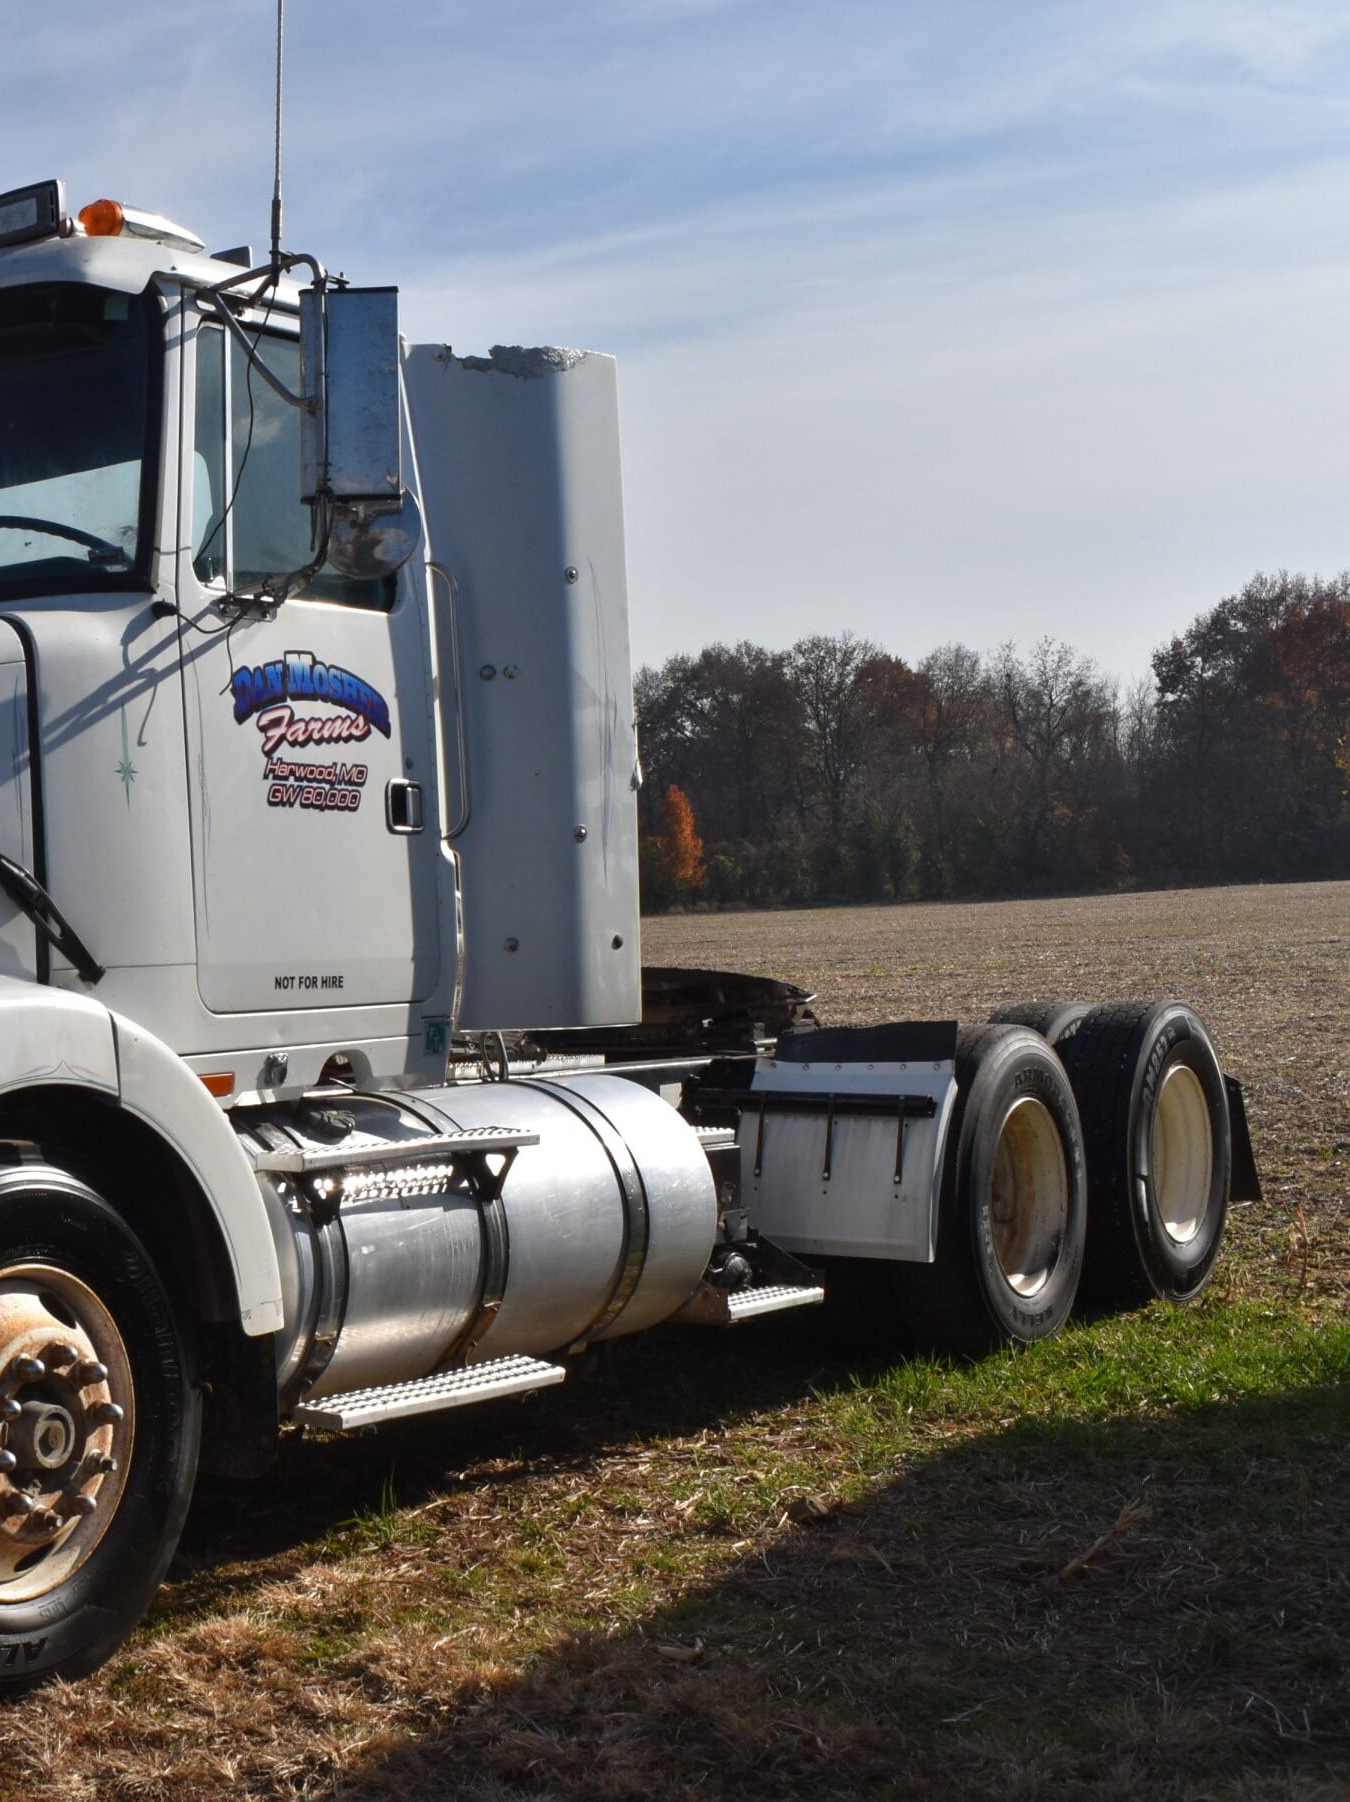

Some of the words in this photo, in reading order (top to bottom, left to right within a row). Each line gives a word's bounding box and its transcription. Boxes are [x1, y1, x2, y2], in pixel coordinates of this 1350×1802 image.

[231, 661, 287, 725] DAN
[256, 705, 372, 757] Farms
[263, 757, 338, 787] Harwood,
[337, 763, 368, 787] MO
[267, 783, 300, 807] GW
[300, 785, 361, 811] 80,000
[274, 976, 296, 990] NOT
[298, 976, 319, 989] FOR
[321, 975, 344, 989] HIRE
